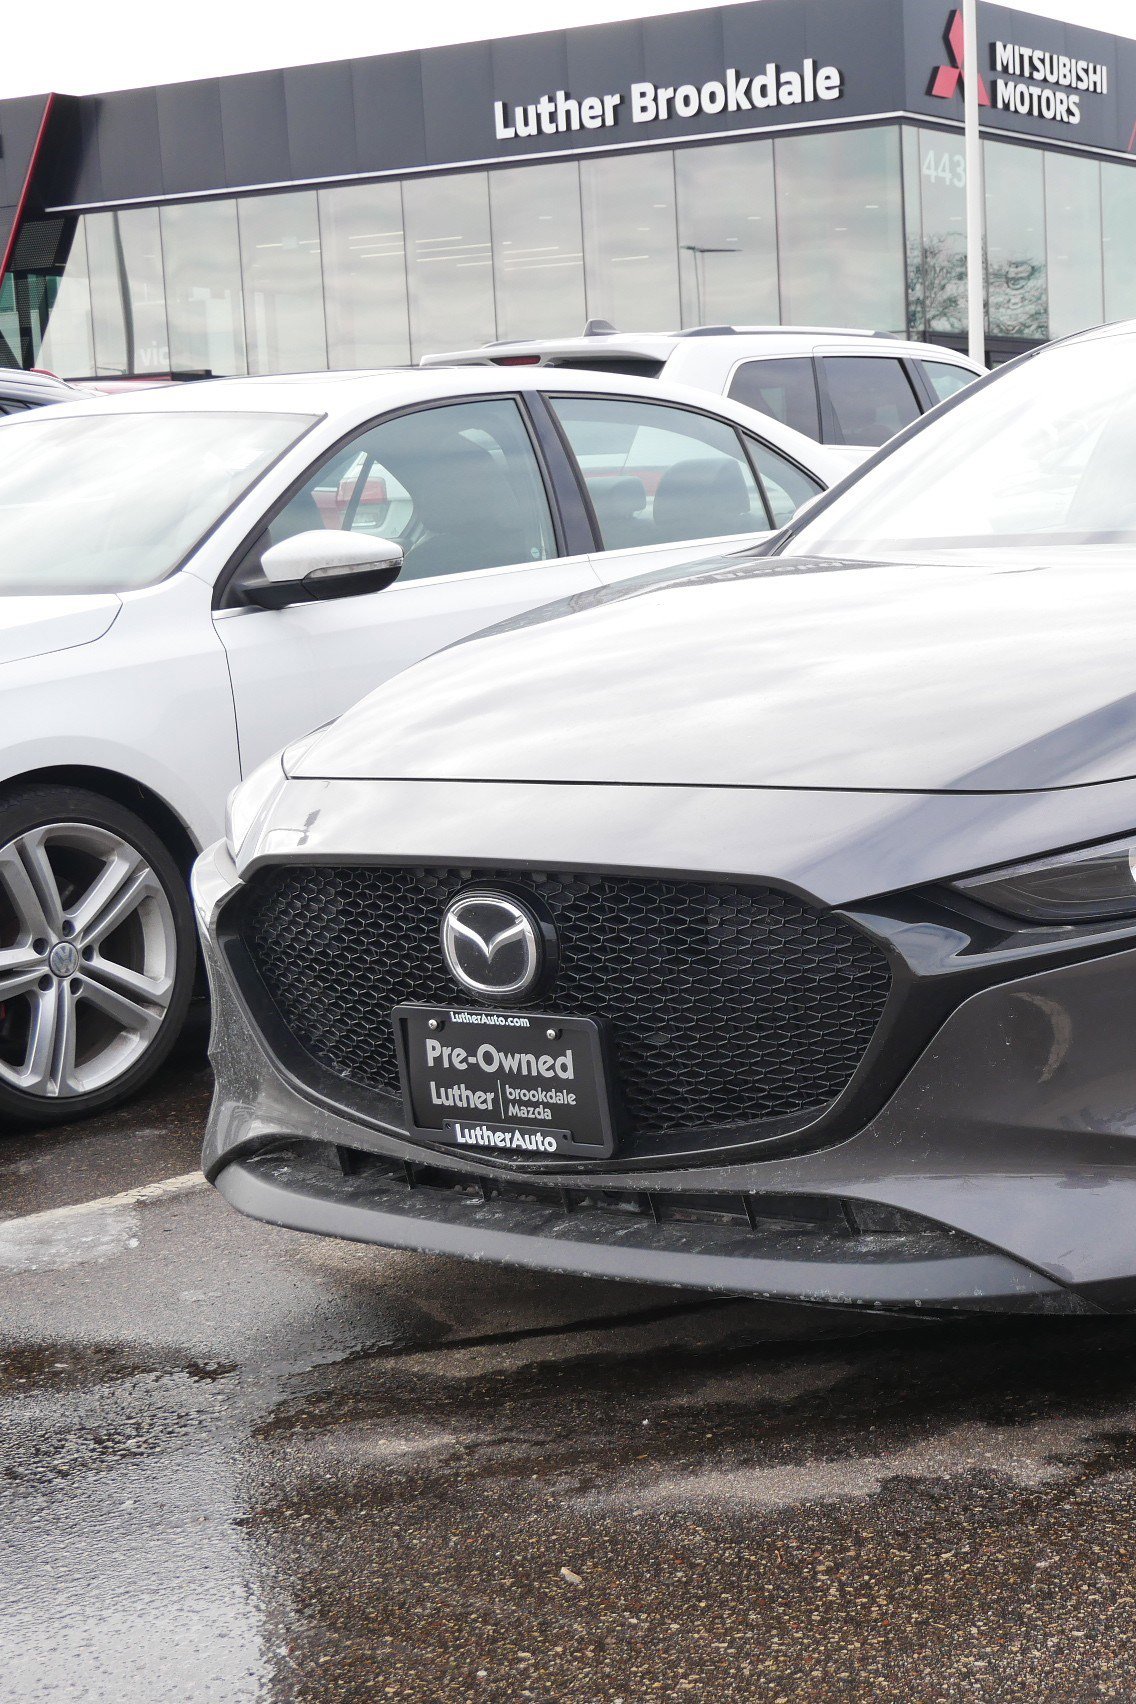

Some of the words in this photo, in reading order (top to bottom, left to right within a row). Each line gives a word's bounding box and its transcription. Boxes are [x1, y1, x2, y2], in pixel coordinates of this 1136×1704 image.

[996, 40, 1107, 94] MITSUBISHI
[493, 90, 621, 140] Luther
[630, 58, 841, 123] Brookdale
[996, 78, 1081, 125] MOTORS
[449, 1011, 531, 1028] LutherAuto.com
[425, 1038, 575, 1080] Pre-Owned
[430, 1081, 495, 1110] Luther
[505, 1084, 577, 1105] brookdale
[508, 1103, 553, 1120] Mazda
[455, 1123, 558, 1152] LutherAuto
